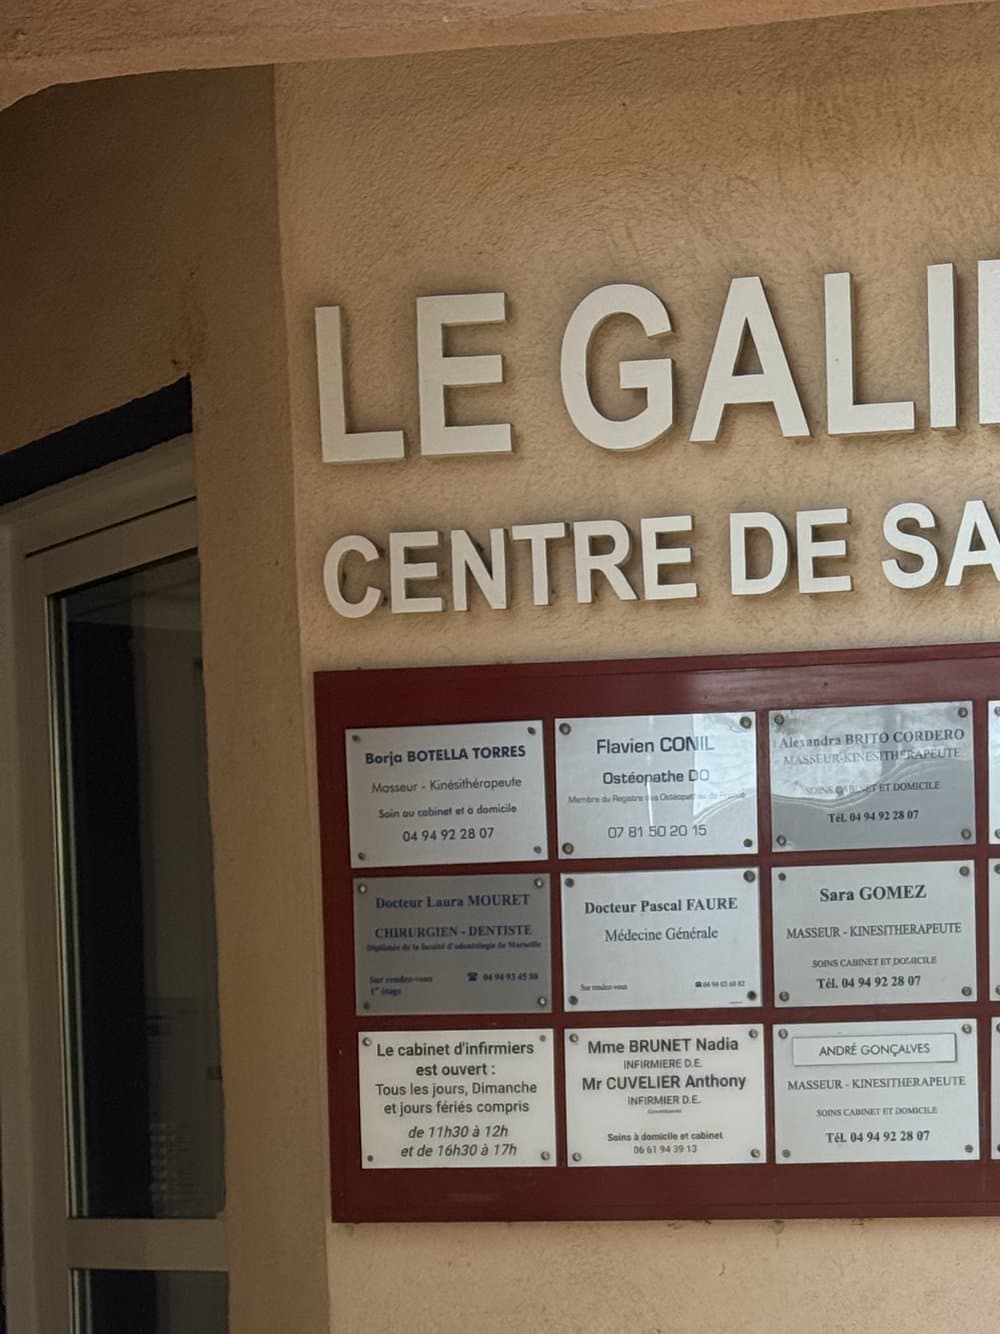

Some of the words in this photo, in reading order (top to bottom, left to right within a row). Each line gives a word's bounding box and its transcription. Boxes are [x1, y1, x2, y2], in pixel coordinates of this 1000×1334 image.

[314, 292, 514, 463] LE
[323, 515, 698, 619] CENTRE
[729, 508, 853, 595] DE
[597, 738, 654, 754] Flavien
[660, 736, 715, 752] CONIL
[779, 736, 841, 748] Alexandra
[845, 732, 889, 745] BRITO
[893, 729, 965, 742] CORDERO
[365, 752, 402, 766] Borja
[408, 749, 468, 762] BOTELLA
[472, 745, 526, 759] TORRES
[603, 770, 684, 785] Ostéopathe
[689, 769, 710, 781] DO
[372, 783, 417, 793] Masseur
[430, 778, 522, 791] Kinésithérapeute
[379, 809, 399, 819] Soin
[402, 809, 414, 817] au
[418, 807, 452, 817] cabinet
[456, 807, 464, 815] et
[477, 803, 517, 815] domicile
[850, 814, 861, 822] 04
[864, 813, 875, 821] 94
[879, 812, 890, 820] 92
[893, 811, 904, 819] 28
[907, 810, 919, 819] 07
[402, 831, 418, 842] 04
[422, 830, 437, 841] 94
[441, 829, 455, 840] 92
[460, 828, 475, 839] 28
[480, 827, 494, 838] 07
[608, 827, 624, 838] 07
[629, 826, 643, 837] 81
[649, 826, 666, 837] 50
[670, 825, 687, 836] 20
[693, 824, 707, 836] 15
[820, 889, 854, 902] Sara
[860, 885, 926, 900] GOMEZ
[376, 897, 423, 909] Docteur
[427, 896, 464, 907] Laura
[468, 894, 530, 906] MOURET
[585, 901, 636, 914] Docteur
[641, 900, 682, 912] Pascal
[687, 897, 737, 910] FAURE
[375, 926, 458, 938] CHIRURGIEN
[469, 925, 532, 936] DENTISTE
[605, 929, 662, 942] Médecine
[666, 926, 718, 940] Générale
[787, 927, 840, 939] MASSEUR
[850, 923, 961, 937] KINESITHERAPEUTE
[812, 959, 838, 968] SOINS
[840, 958, 878, 967] CABINET
[881, 958, 891, 966] ET
[893, 956, 937, 966] DOMICILE
[842, 978, 854, 988] 04
[858, 977, 871, 988] 94
[875, 977, 888, 987] 92
[892, 976, 904, 986] 28
[908, 976, 921, 985] 07
[377, 1044, 393, 1056] Le
[398, 1043, 450, 1056] cabinet
[454, 1041, 534, 1055] d'infirmiers
[588, 1041, 624, 1054] Mme
[629, 1039, 691, 1053] BRUNET
[696, 1037, 738, 1051] Nadia
[819, 1042, 856, 1057] ANDRÉ
[861, 1043, 930, 1057] GONÇALVES
[416, 1065, 437, 1076] est
[442, 1064, 488, 1076] ouvert
[624, 1059, 682, 1069] INFIRMIERE
[685, 1059, 702, 1068] D.E.
[376, 1083, 406, 1096] Tous
[410, 1083, 428, 1095] les
[432, 1083, 468, 1097] jours,
[472, 1081, 537, 1094] Dimanche
[583, 1078, 602, 1090] Mr
[607, 1075, 680, 1090] CUVELIER
[685, 1074, 746, 1090] Anthony
[788, 1079, 842, 1091] MASSEUR
[852, 1076, 966, 1089] KINESITHERAPEUTE
[628, 1096, 679, 1106] INFIRMIER
[682, 1095, 700, 1105] D.E.
[384, 1104, 396, 1114] et
[400, 1103, 432, 1117] jours
[436, 1101, 472, 1113] fériés
[477, 1101, 529, 1115] compris
[817, 1109, 841, 1117] SOINS
[844, 1108, 880, 1116] CABINET
[883, 1107, 893, 1115] ET
[895, 1106, 937, 1115] DOMICILE
[409, 1126, 424, 1138] de
[429, 1126, 468, 1138] 11h30
[473, 1126, 479, 1137] à
[486, 1125, 508, 1137] 12h
[608, 1133, 632, 1142] Soins
[634, 1132, 639, 1140] à
[641, 1132, 678, 1141] domicile
[680, 1132, 688, 1140] et
[691, 1131, 723, 1140] cabinet
[851, 1132, 863, 1143] 04
[867, 1132, 880, 1142] 94
[884, 1131, 896, 1142] 92
[900, 1131, 913, 1141] 28
[917, 1130, 930, 1141] 07
[401, 1146, 413, 1157] et
[417, 1145, 433, 1157] de
[438, 1144, 477, 1156] 16h30
[481, 1144, 488, 1156] à
[494, 1144, 517, 1155] 17h
[633, 1145, 644, 1154] 06
[647, 1145, 656, 1154] 61
[659, 1145, 670, 1153] 94
[673, 1145, 683, 1153] 39
